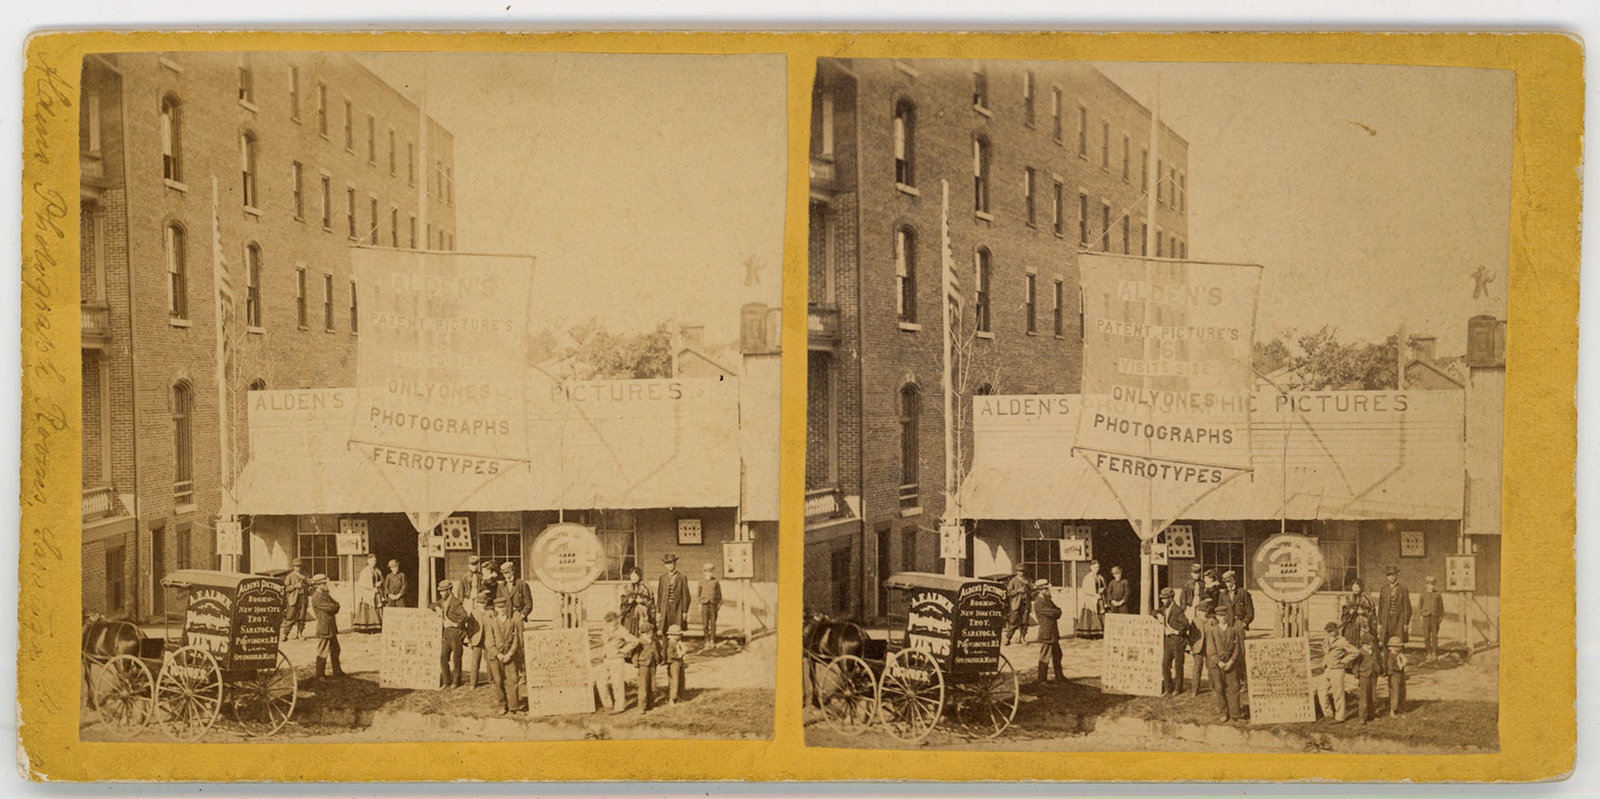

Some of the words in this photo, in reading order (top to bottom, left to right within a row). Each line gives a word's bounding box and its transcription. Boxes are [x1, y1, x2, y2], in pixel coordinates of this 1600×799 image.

[26, 183, 68, 380] Photograph
[393, 274, 496, 299] ALDEN'S
[1119, 280, 1222, 307] ALDEN'S
[370, 313, 425, 330] PATENT
[1097, 319, 1152, 337] PATENT
[1162, 326, 1239, 341] PICTURE'S
[1121, 360, 1170, 374] VISITE
[1175, 362, 1211, 376] SIZE
[254, 392, 345, 411] ALDEN'S
[550, 382, 683, 403] PICTURES
[980, 397, 1070, 416] ALDEN'S
[1275, 394, 1409, 413] PICTURES
[1113, 386, 1159, 406] ONLY
[370, 407, 510, 435] PHOTOGRAPHS
[1094, 414, 1233, 444] PHOTOGRAPHS
[373, 447, 500, 475] FERROTYPES
[1096, 454, 1222, 483] FERROTYPES
[187, 632, 230, 654] VIEWS
[909, 634, 952, 656] VIEWS
